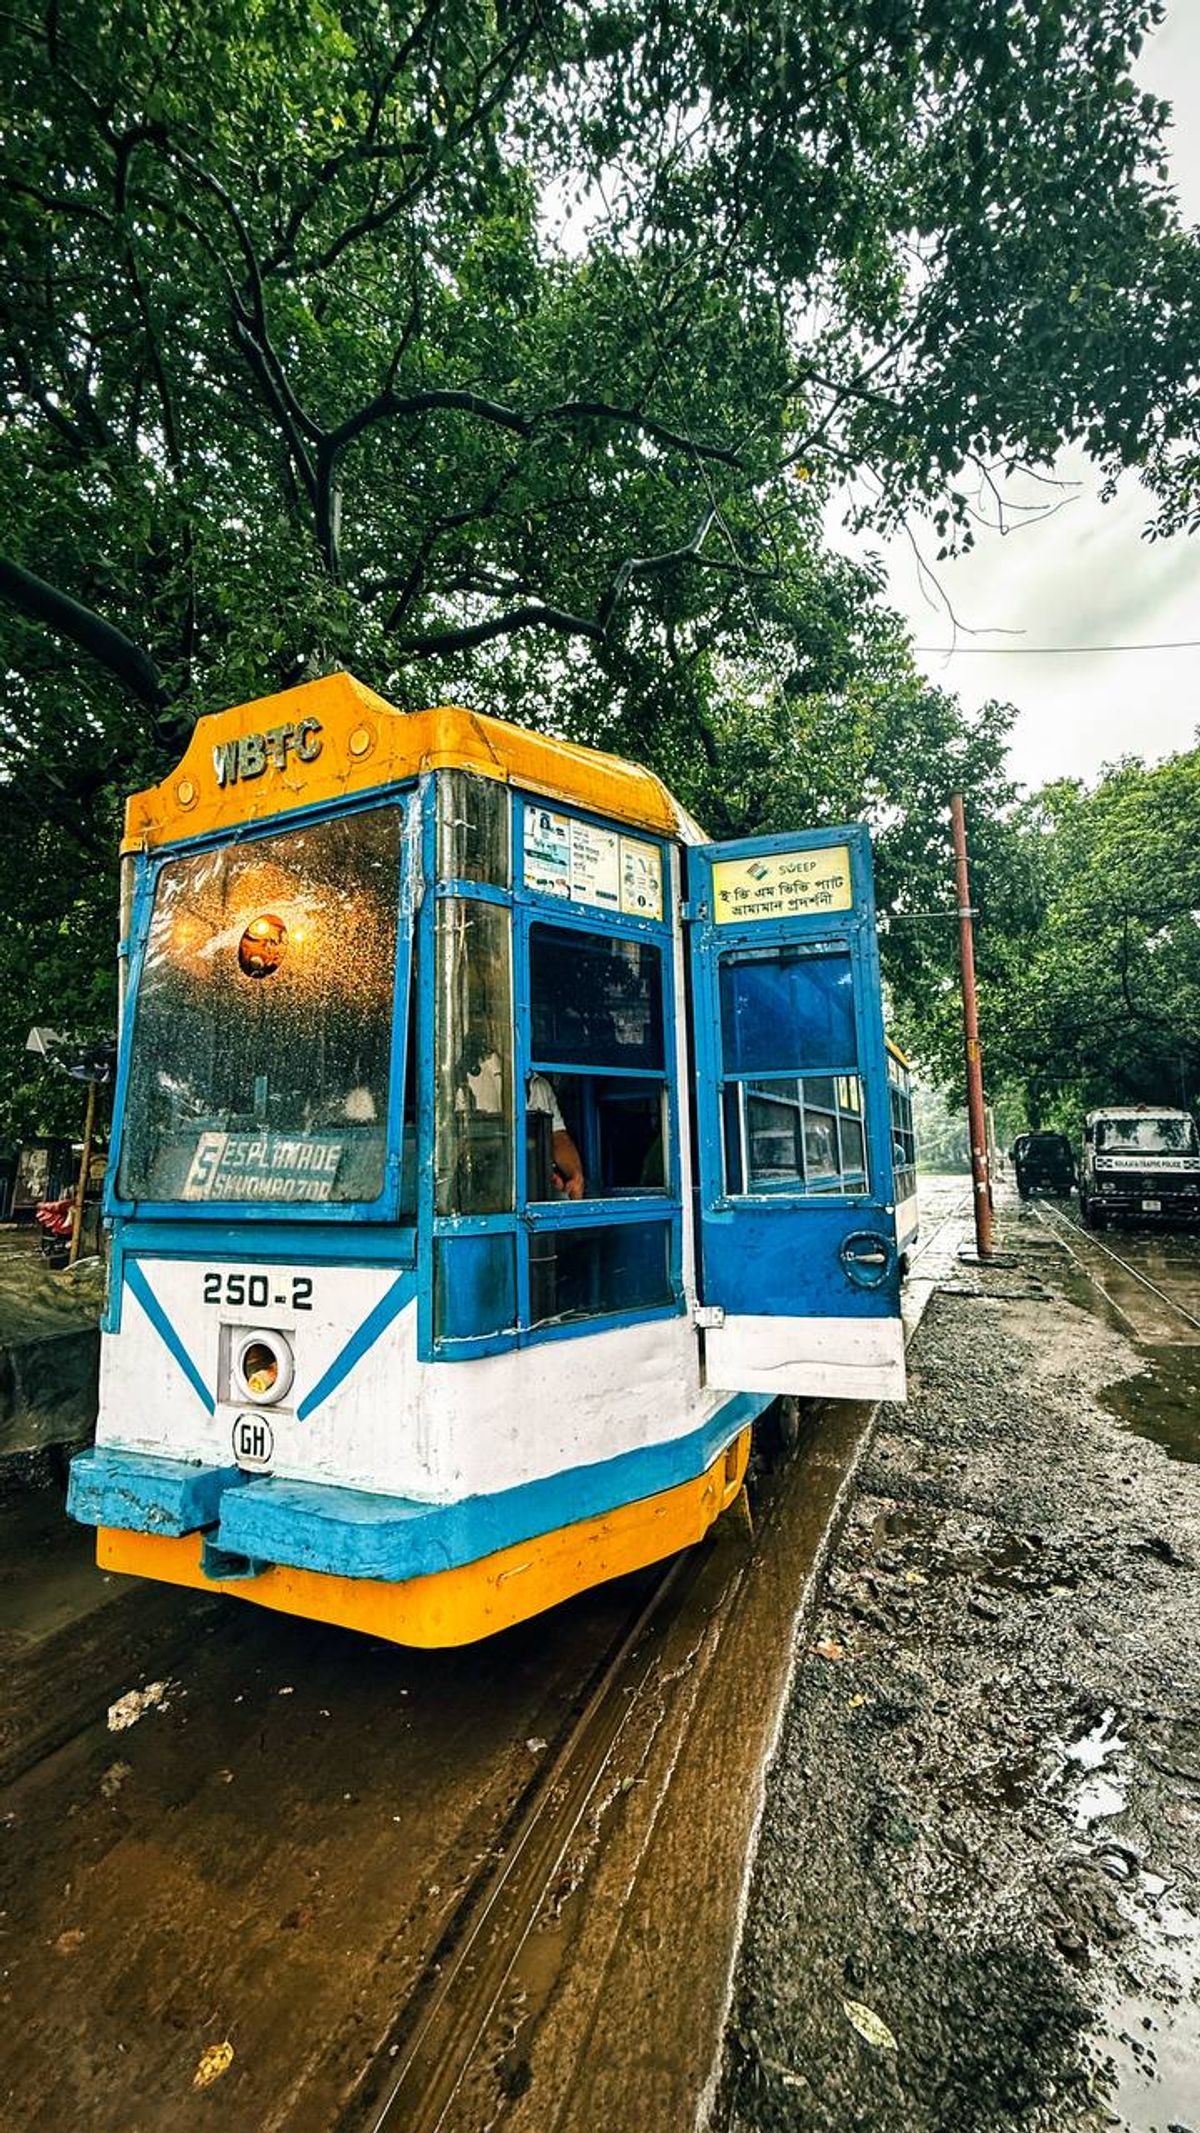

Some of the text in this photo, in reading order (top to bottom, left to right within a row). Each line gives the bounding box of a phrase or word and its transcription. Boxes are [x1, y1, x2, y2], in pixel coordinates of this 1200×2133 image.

[213, 717, 322, 788] WBTC
[778, 861, 817, 876] SWEEP
[719, 889, 731, 903] ই
[733, 886, 750, 901] ভি
[754, 886, 775, 898] এম
[778, 880, 811, 896] ভিভি
[787, 891, 833, 911] প্রদর্শনী
[221, 1140, 342, 1171] ESPLANADE
[1162, 1160, 1181, 1168] POLICE
[204, 1273, 312, 1310] 250-2
[240, 1424, 265, 1457] GH
